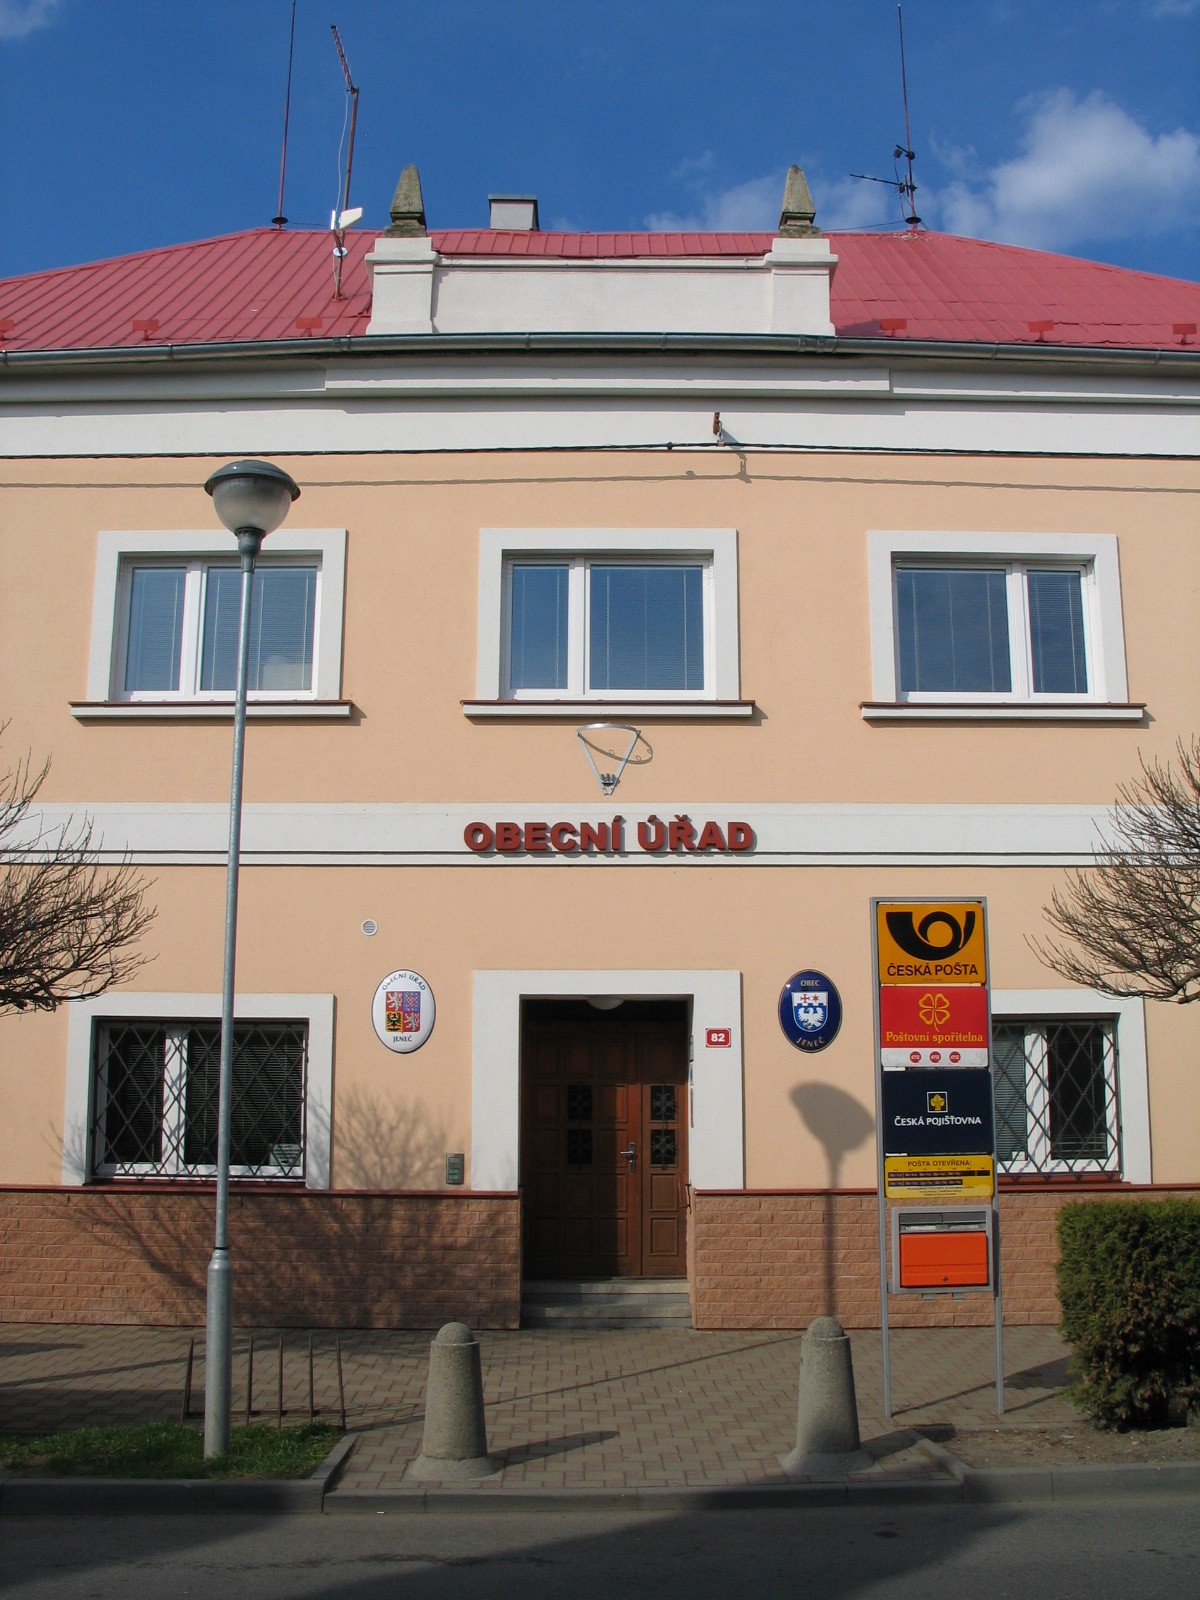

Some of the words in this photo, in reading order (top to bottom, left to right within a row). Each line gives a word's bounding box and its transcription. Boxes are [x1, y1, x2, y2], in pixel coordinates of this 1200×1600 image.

[463, 815, 623, 851] OBECNÍ
[637, 815, 752, 851] ÚŘAD
[887, 962, 932, 977] ČESKÁ
[934, 962, 978, 976] POŠTA
[393, 1035, 413, 1043] JENEČ
[711, 1033, 726, 1042] 82
[796, 1036, 825, 1047] JENEČ
[886, 1031, 929, 1042] Poštovní
[932, 1031, 983, 1044] spořitelna
[894, 1116, 925, 1126] ČESKÁ
[926, 1115, 982, 1127] POJIŠŤOVNA
